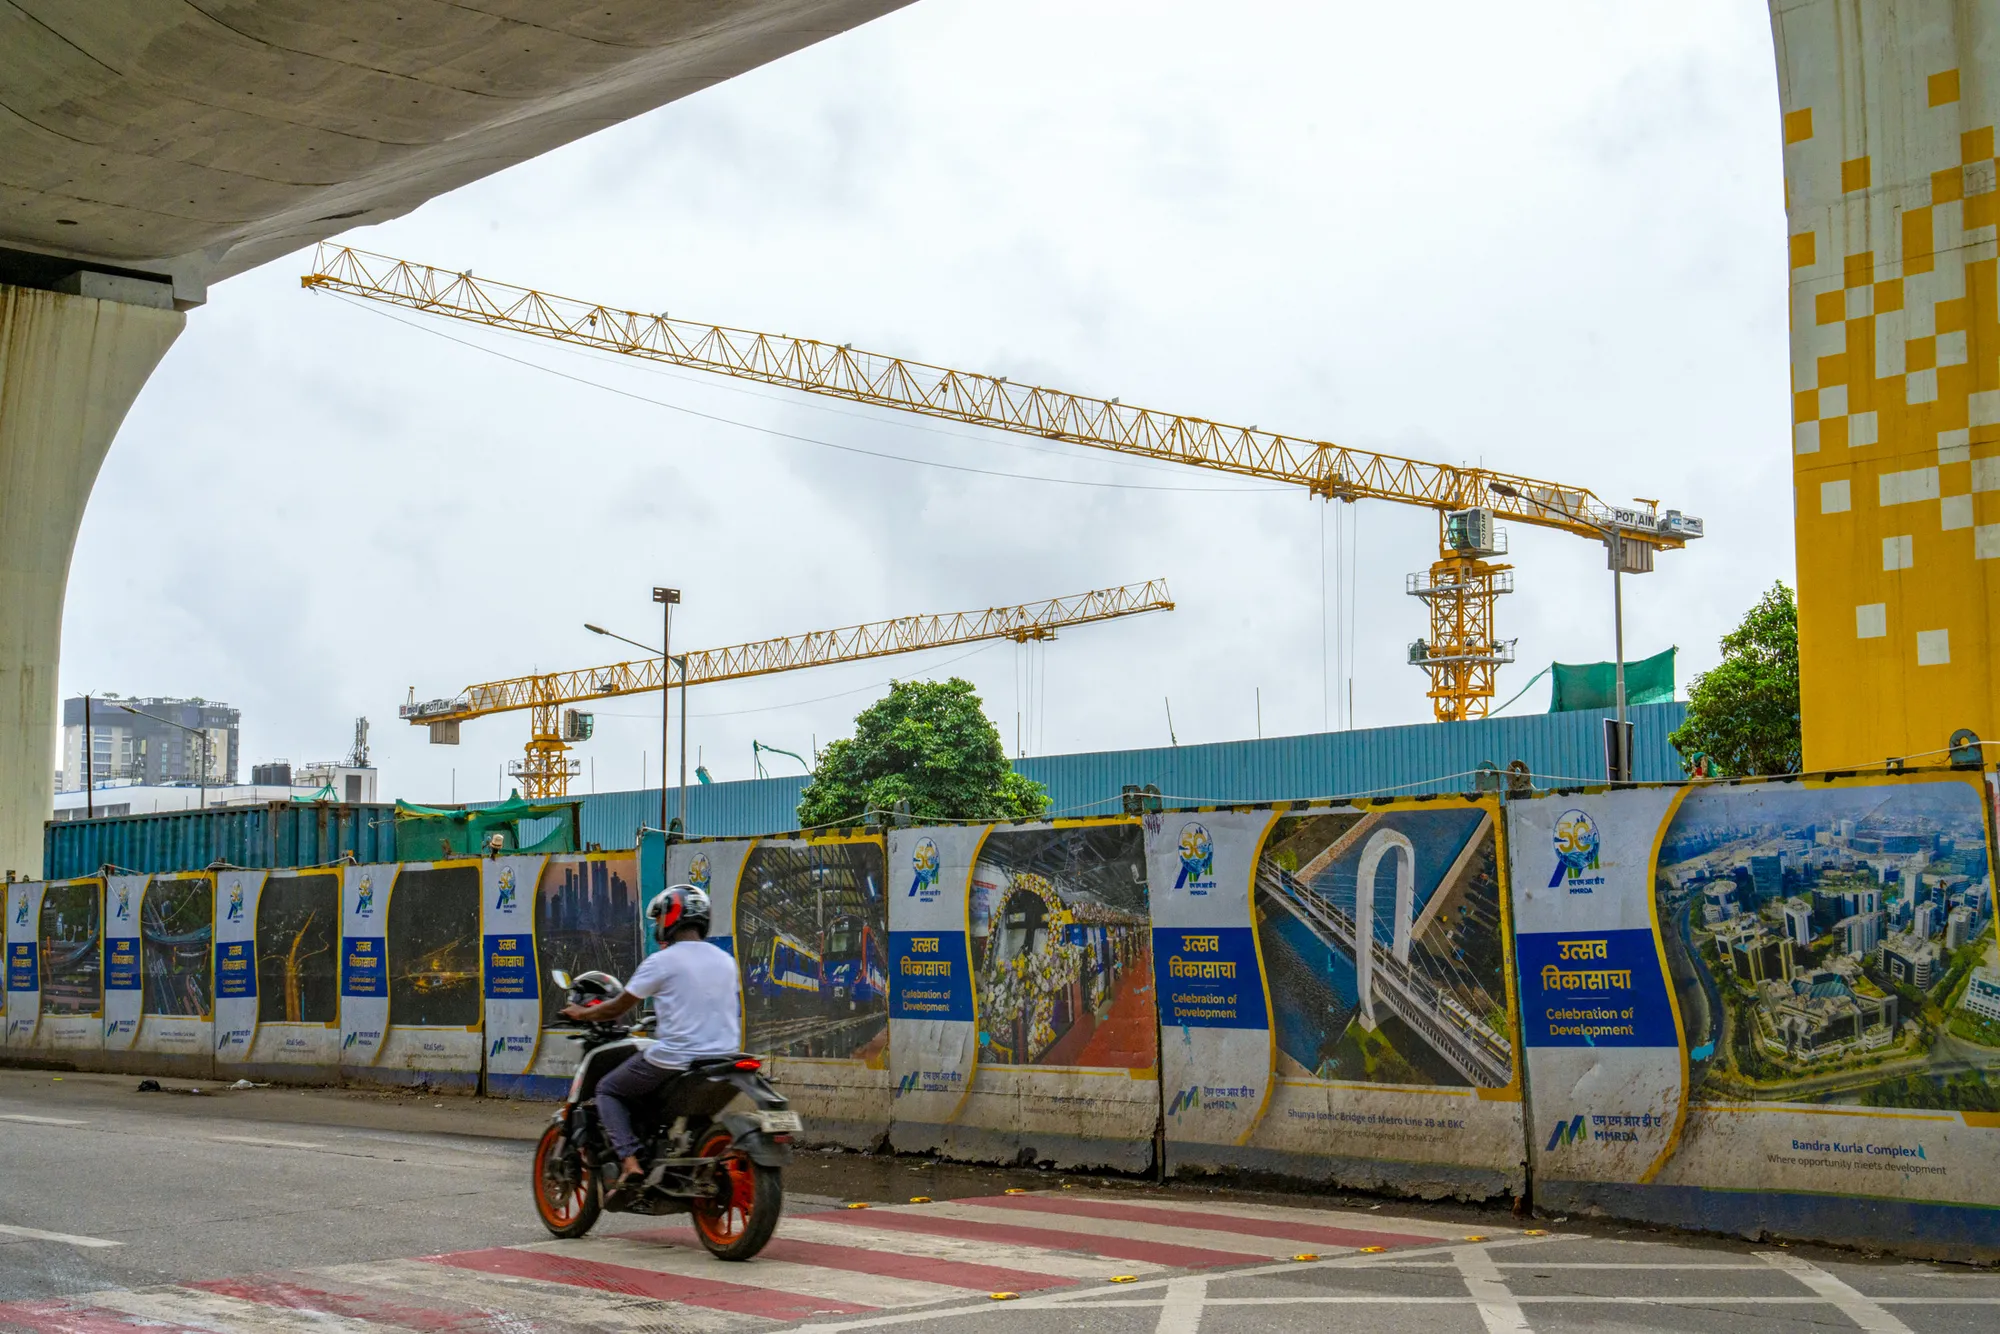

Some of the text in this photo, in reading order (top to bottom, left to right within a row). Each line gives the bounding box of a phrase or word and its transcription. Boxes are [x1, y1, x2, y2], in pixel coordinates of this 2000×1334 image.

[911, 938, 939, 952] उत्सव
[1182, 936, 1219, 952] उत्सव
[1557, 940, 1608, 960] उत्सव
[900, 956, 952, 976] विकासाचा
[1168, 955, 1236, 979] विकासाचा
[1541, 964, 1632, 991] विकासाचा
[902, 989, 951, 999] Celebration of
[1172, 993, 1237, 1004] Celebration of
[903, 1002, 950, 1012] Development
[1174, 1007, 1237, 1020] Development
[1546, 1007, 1634, 1020] Celebration of
[1550, 1024, 1634, 1039] Development
[1204, 1100, 1237, 1110] MMRDA
[1288, 1108, 1465, 1129] Shunya Iconic Bridge of Metro Line 2B at BKC
[1594, 1130, 1638, 1142] MMRDA
[1792, 1139, 1916, 1160] Bandra Kurla Complex
[1767, 1154, 1947, 1176] Where opportunity meets development
